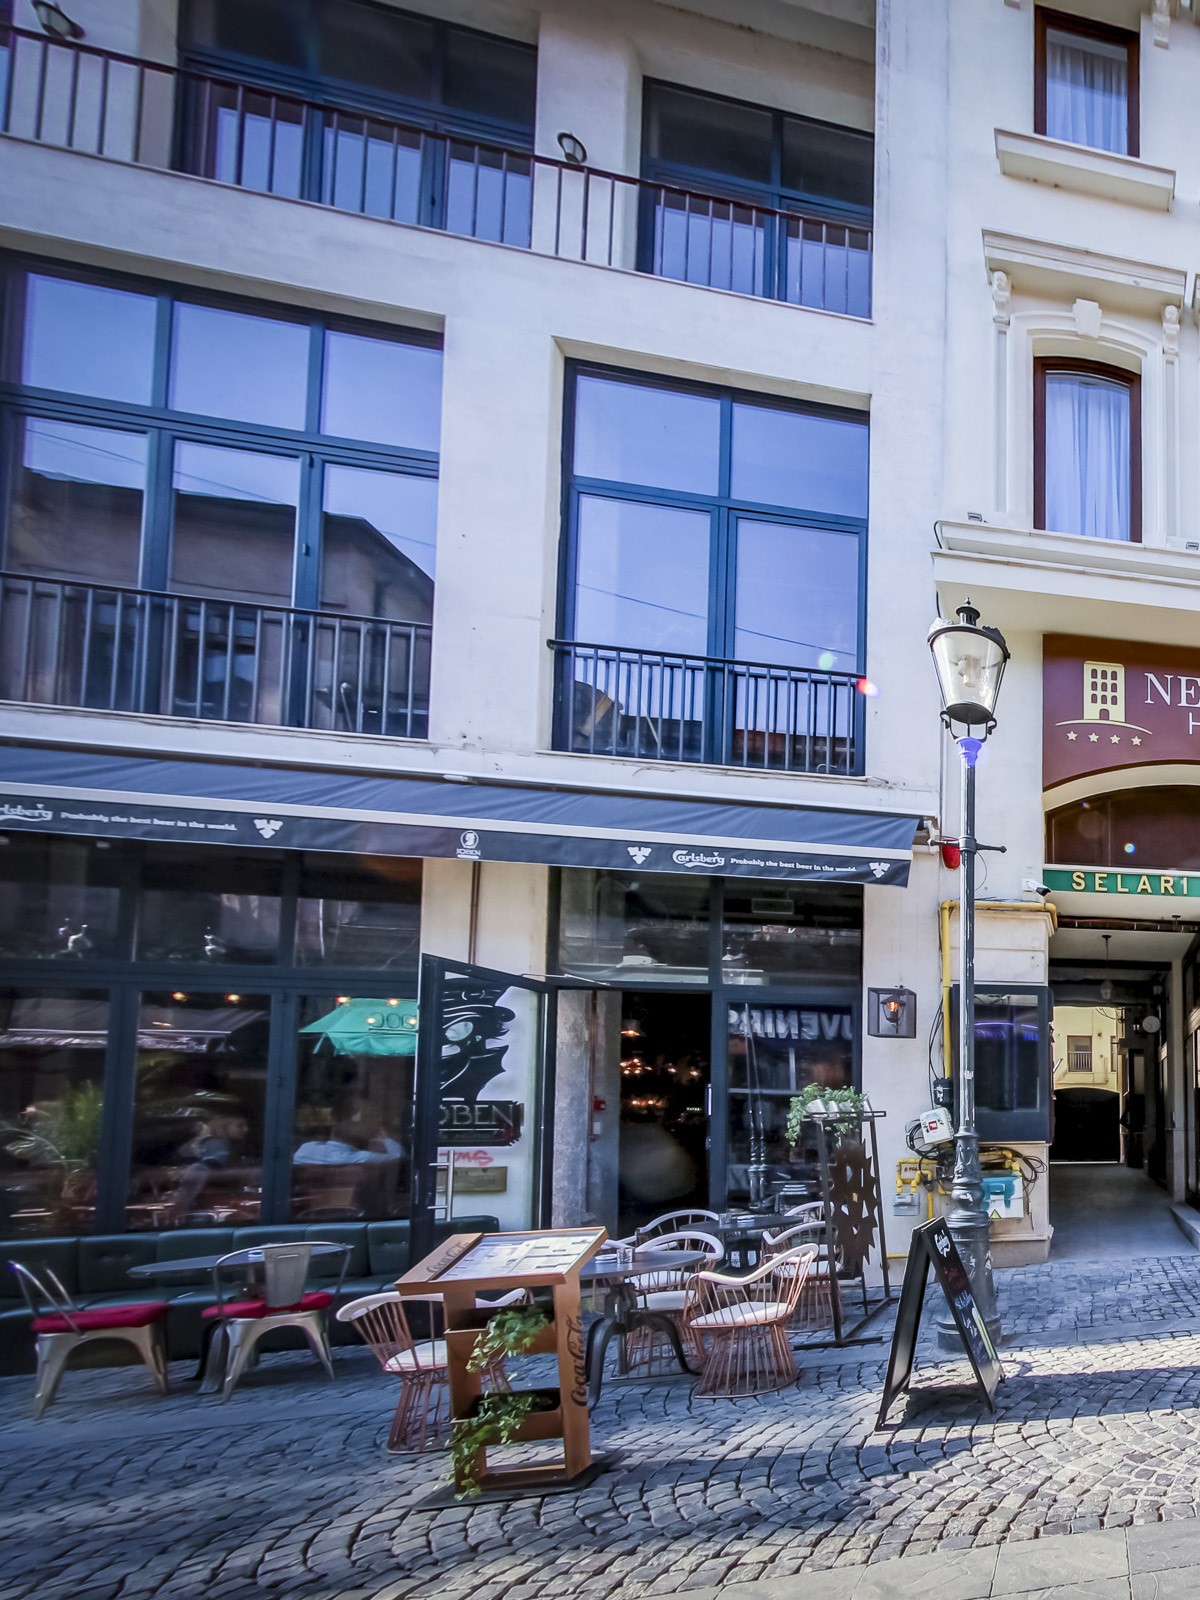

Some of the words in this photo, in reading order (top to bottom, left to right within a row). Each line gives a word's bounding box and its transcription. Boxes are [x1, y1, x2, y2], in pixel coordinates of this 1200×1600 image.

[672, 849, 725, 868] Carlsberg
[730, 857, 764, 867] Probably
[766, 859, 778, 867] the
[779, 861, 795, 869] best
[796, 862, 813, 870] beer
[1072, 871, 1188, 896] SELARI
